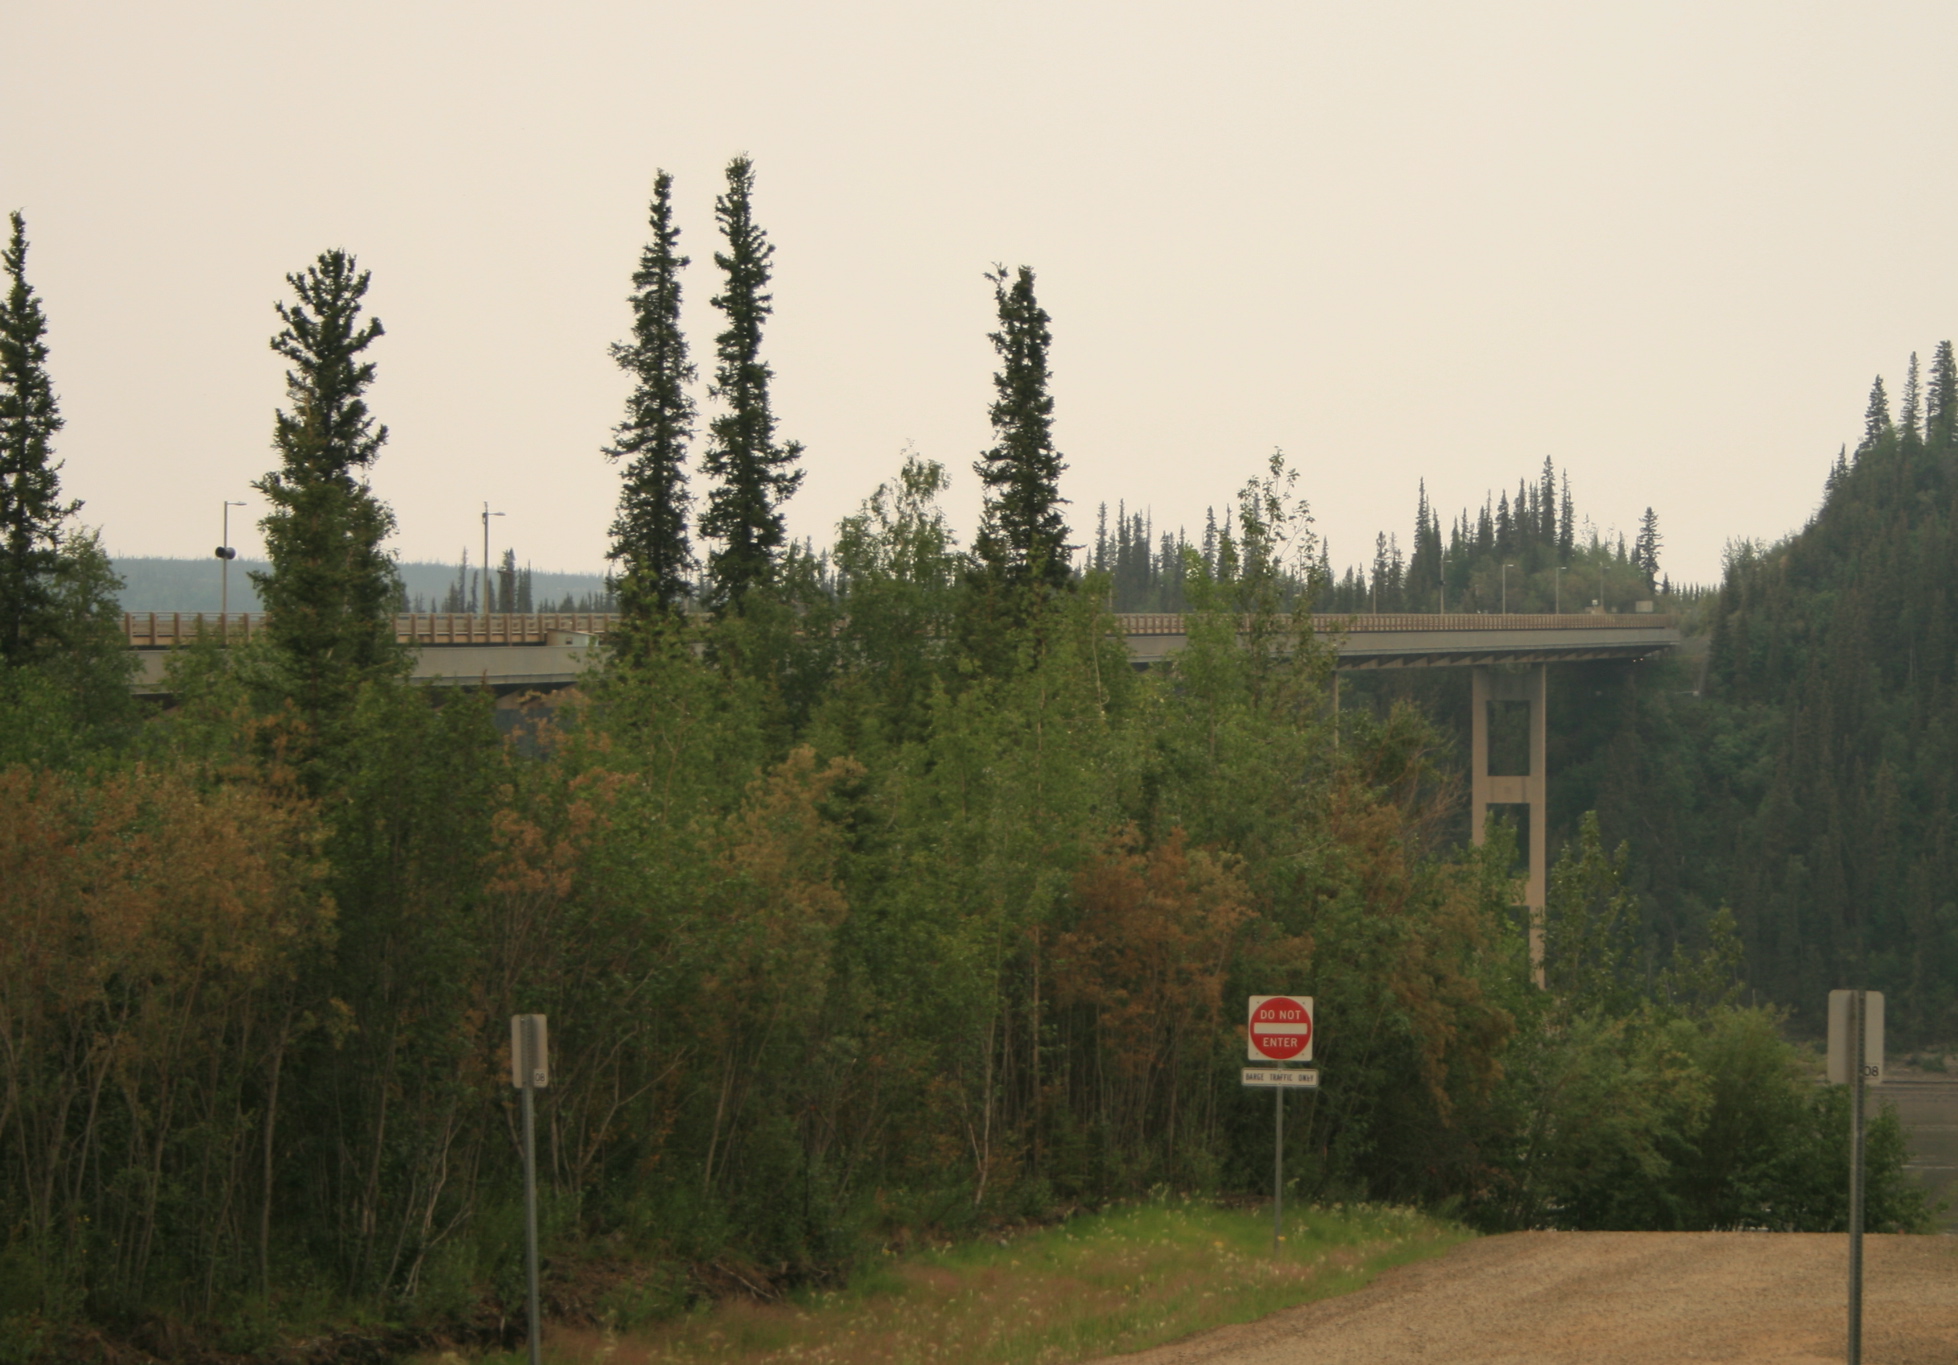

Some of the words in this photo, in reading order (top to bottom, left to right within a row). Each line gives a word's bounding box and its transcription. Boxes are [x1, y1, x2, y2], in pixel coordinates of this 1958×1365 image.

[1260, 1010, 1275, 1020] DO
[1279, 1010, 1301, 1020] NOT
[1263, 1037, 1298, 1047] ENTER
[1245, 1073, 1264, 1081] BARGE
[1270, 1073, 1293, 1082] TRAFFIC
[1298, 1074, 1314, 1082] ONLY
